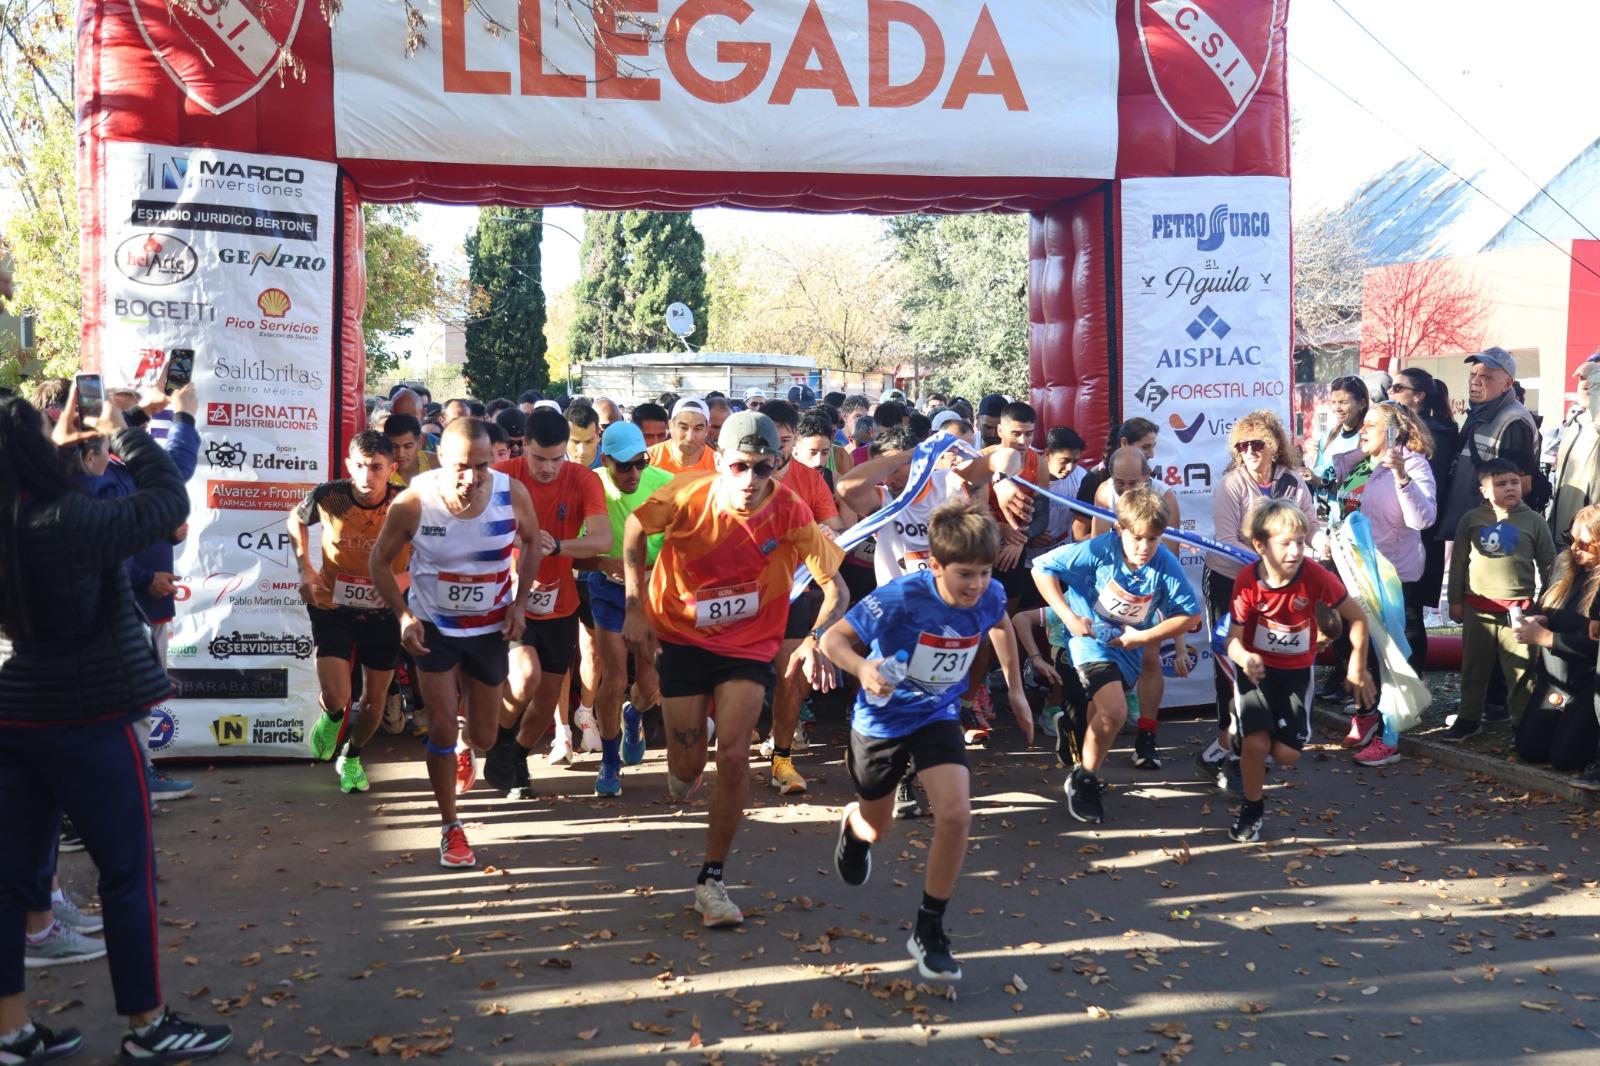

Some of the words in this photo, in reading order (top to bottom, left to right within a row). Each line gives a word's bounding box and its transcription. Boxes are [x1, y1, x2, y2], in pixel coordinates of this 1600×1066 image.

[443, 0, 1029, 112] LLEGADA
[1175, 7, 1240, 87] C.S.I.
[200, 160, 305, 184] MARCO
[200, 177, 303, 198] inversiones
[137, 208, 192, 221] ESTUDIO
[194, 212, 252, 226] JURIDICO
[255, 219, 313, 232] BERTONE
[219, 243, 326, 276] GENPRO
[1204, 260, 1219, 269] EL
[115, 299, 214, 321] BOGETTI
[225, 316, 255, 330] Pico
[259, 319, 319, 335] Servicios
[1156, 346, 1262, 368] AISPLAC
[214, 358, 323, 390] Salúbritas
[219, 384, 258, 394] Centro
[1170, 382, 1249, 400] FORESTAL
[1252, 381, 1284, 397] PICO
[234, 403, 318, 421] PIGNATTA
[234, 418, 318, 431] DISTRIBUCIONES
[252, 453, 318, 471] Edreira
[211, 484, 260, 499] Alvarez
[219, 499, 257, 508] FARMACIA
[229, 595, 252, 606] Pablo
[448, 585, 484, 603] 875
[709, 597, 747, 621] 812
[1108, 598, 1142, 618] 732
[226, 642, 299, 654] SERVIDIESEL
[1266, 631, 1301, 647] 944
[931, 651, 968, 672] 731
[253, 717, 275, 729] Juan
[276, 717, 304, 728] Carlos
[252, 726, 304, 745] Narcisi
